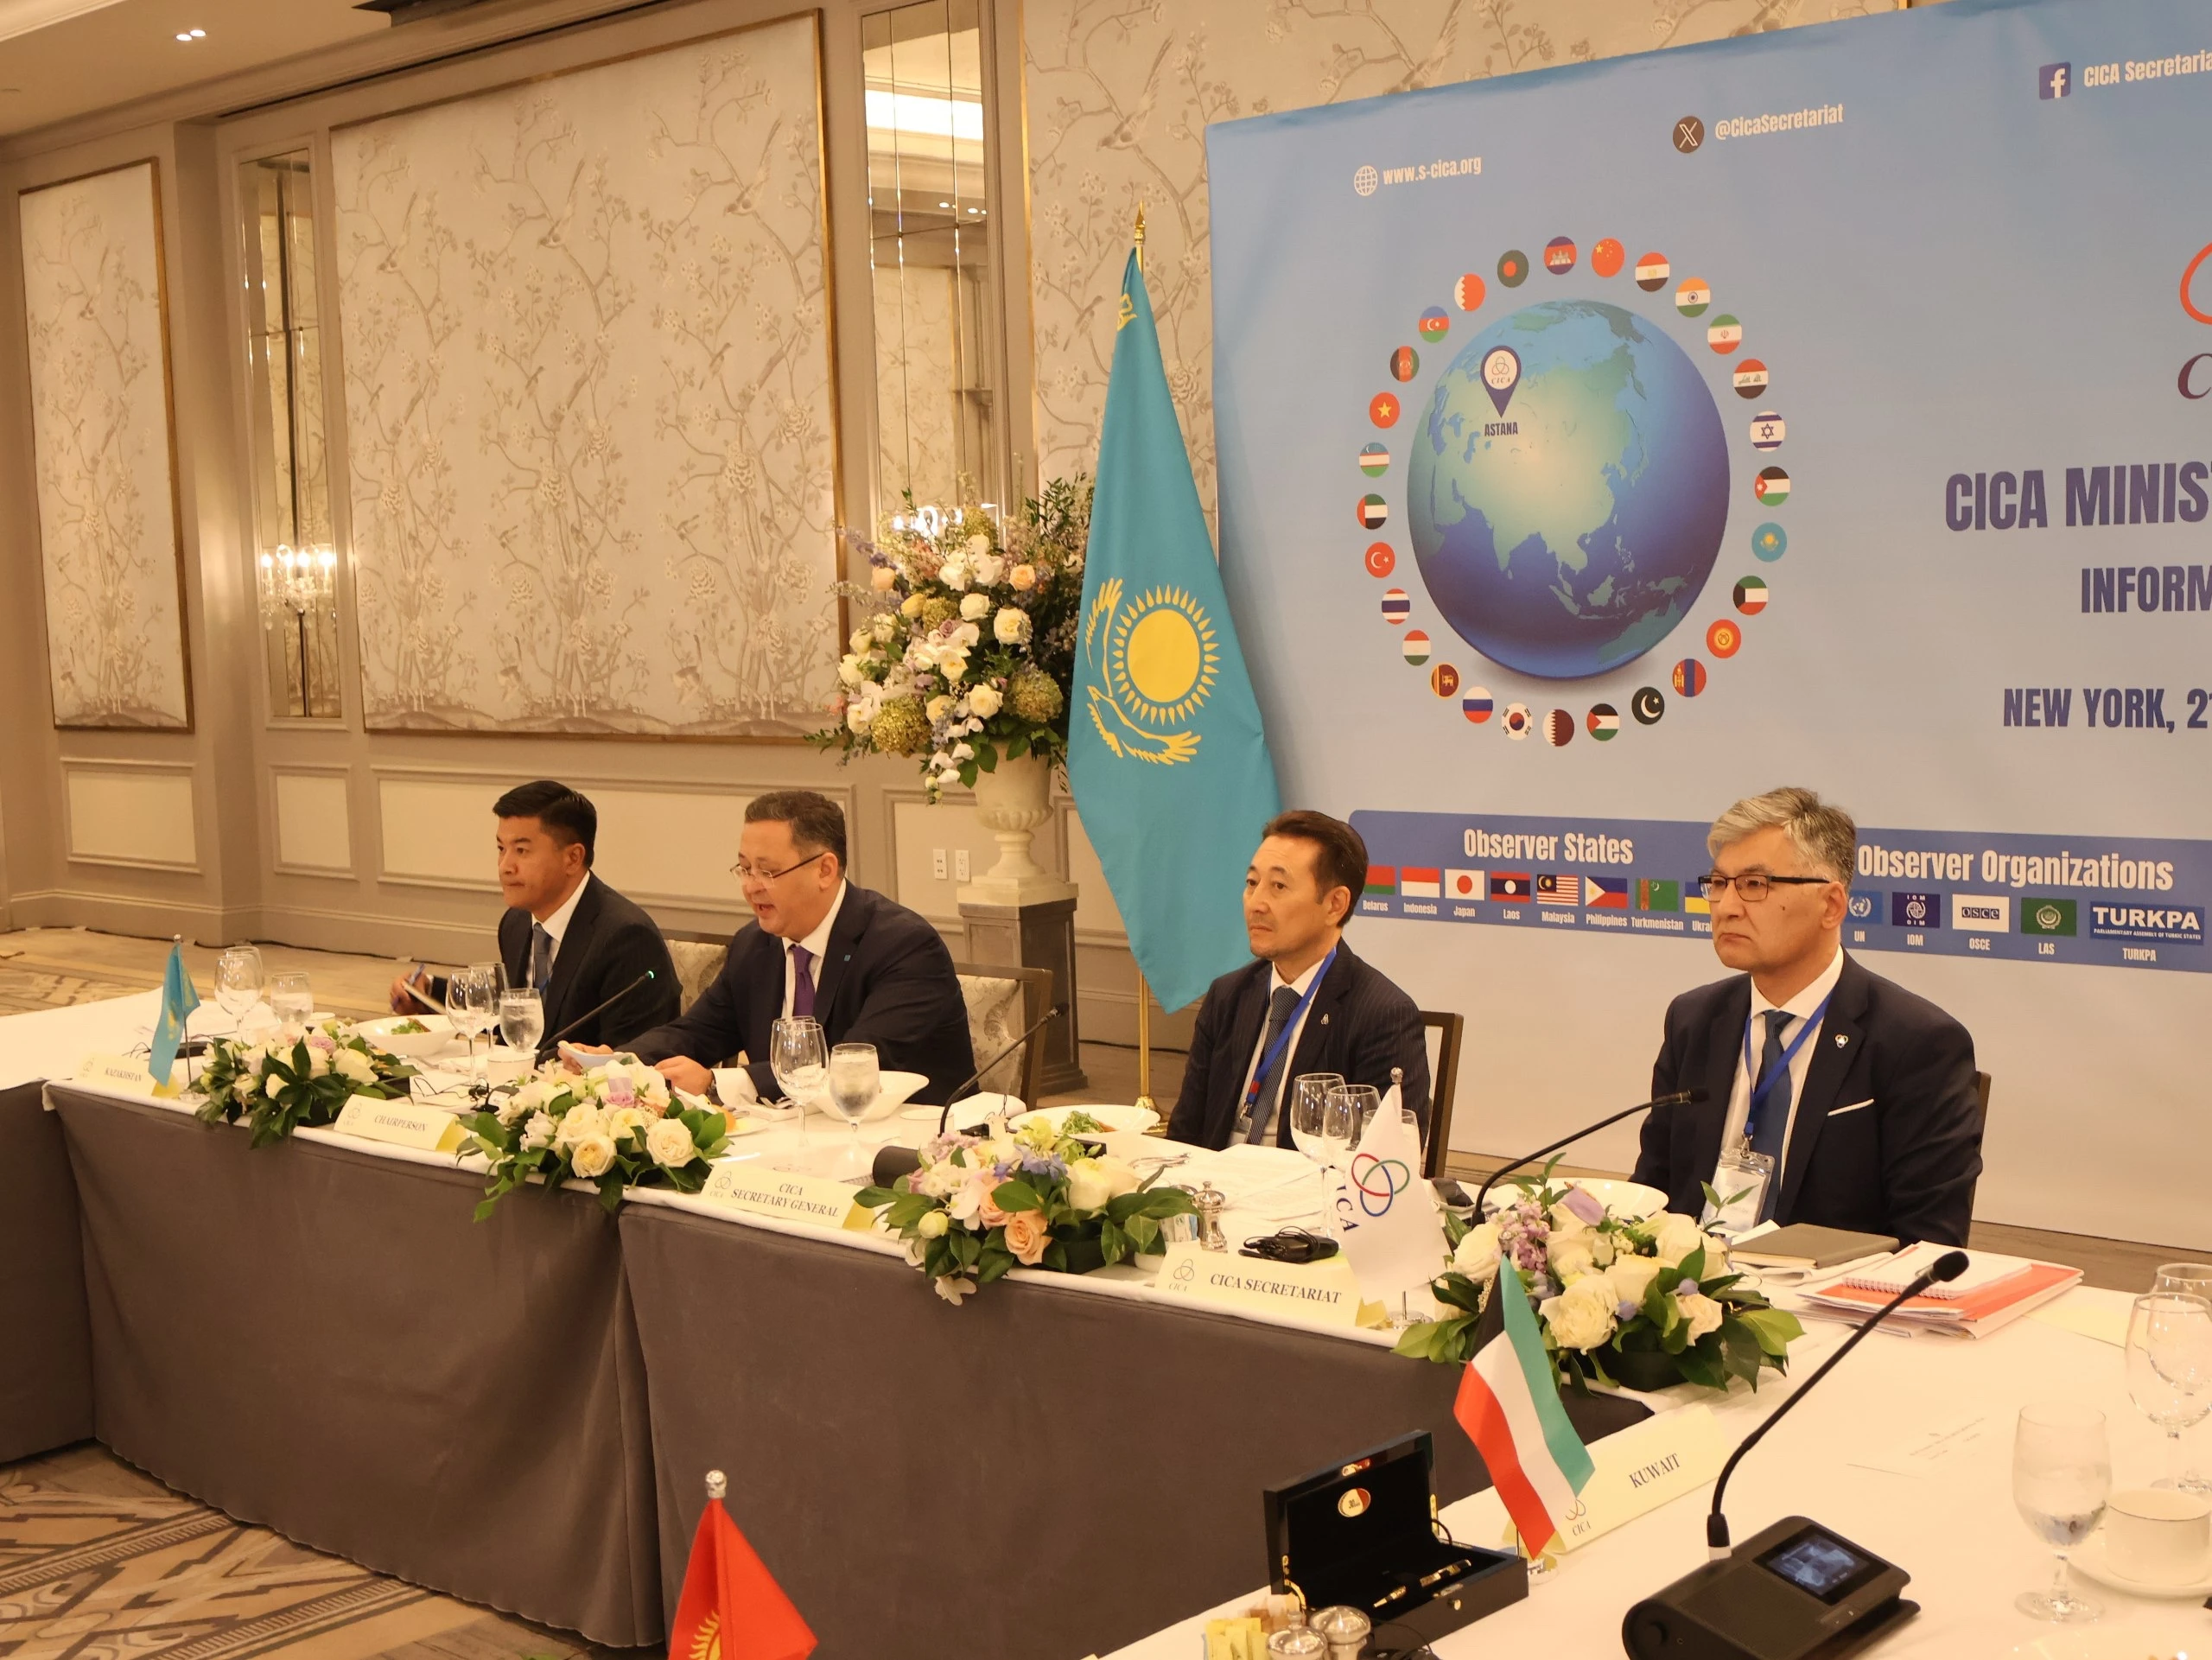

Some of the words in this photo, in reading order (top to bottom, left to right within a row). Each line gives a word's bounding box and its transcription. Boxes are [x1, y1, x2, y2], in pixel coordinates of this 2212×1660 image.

[2083, 63, 2120, 87] CICA
[1715, 103, 1844, 140] @CicaSecretariat
[1383, 156, 1482, 185] www.s-cica.org
[1484, 421, 1519, 437] ASTANA
[1945, 469, 2048, 531] CICA
[2066, 461, 2212, 526] MINIS
[2082, 565, 2212, 614] INFORM
[2003, 688, 2072, 727] NEW
[2083, 688, 2175, 734] YORK,
[2187, 688, 2212, 728] 2
[1464, 828, 1558, 862] Observer
[1564, 832, 1634, 865] States
[1858, 844, 1974, 881] Observer
[1981, 850, 2174, 890] Organizations
[1363, 900, 1389, 912] Belarus
[1403, 902, 1438, 915] Indonesia
[1453, 906, 1476, 919] Japan
[1503, 908, 1521, 920] Laos
[1541, 911, 1575, 925] Malaysia
[1586, 913, 1628, 927] Philippines
[1630, 916, 1684, 931] Turkmenistan
[2093, 906, 2200, 931] TURKPA
[1854, 930, 1866, 942] UN
[1907, 934, 1923, 946] IOM
[1968, 938, 1991, 951] OSCE
[2038, 942, 2055, 955] LAS
[2122, 947, 2157, 962] TURKPA
[374, 1114, 427, 1132] CHAIRPERSON
[779, 1183, 804, 1196] CICA
[731, 1188, 788, 1208] SECRETARY
[790, 1199, 839, 1218] GENERAL
[1168, 1282, 1188, 1293] CICA
[1210, 1273, 1242, 1289] CICA
[1244, 1278, 1342, 1304] SECRETARIAT
[1629, 1453, 1681, 1489] KUWAIT
[1572, 1520, 1592, 1536] CICA
